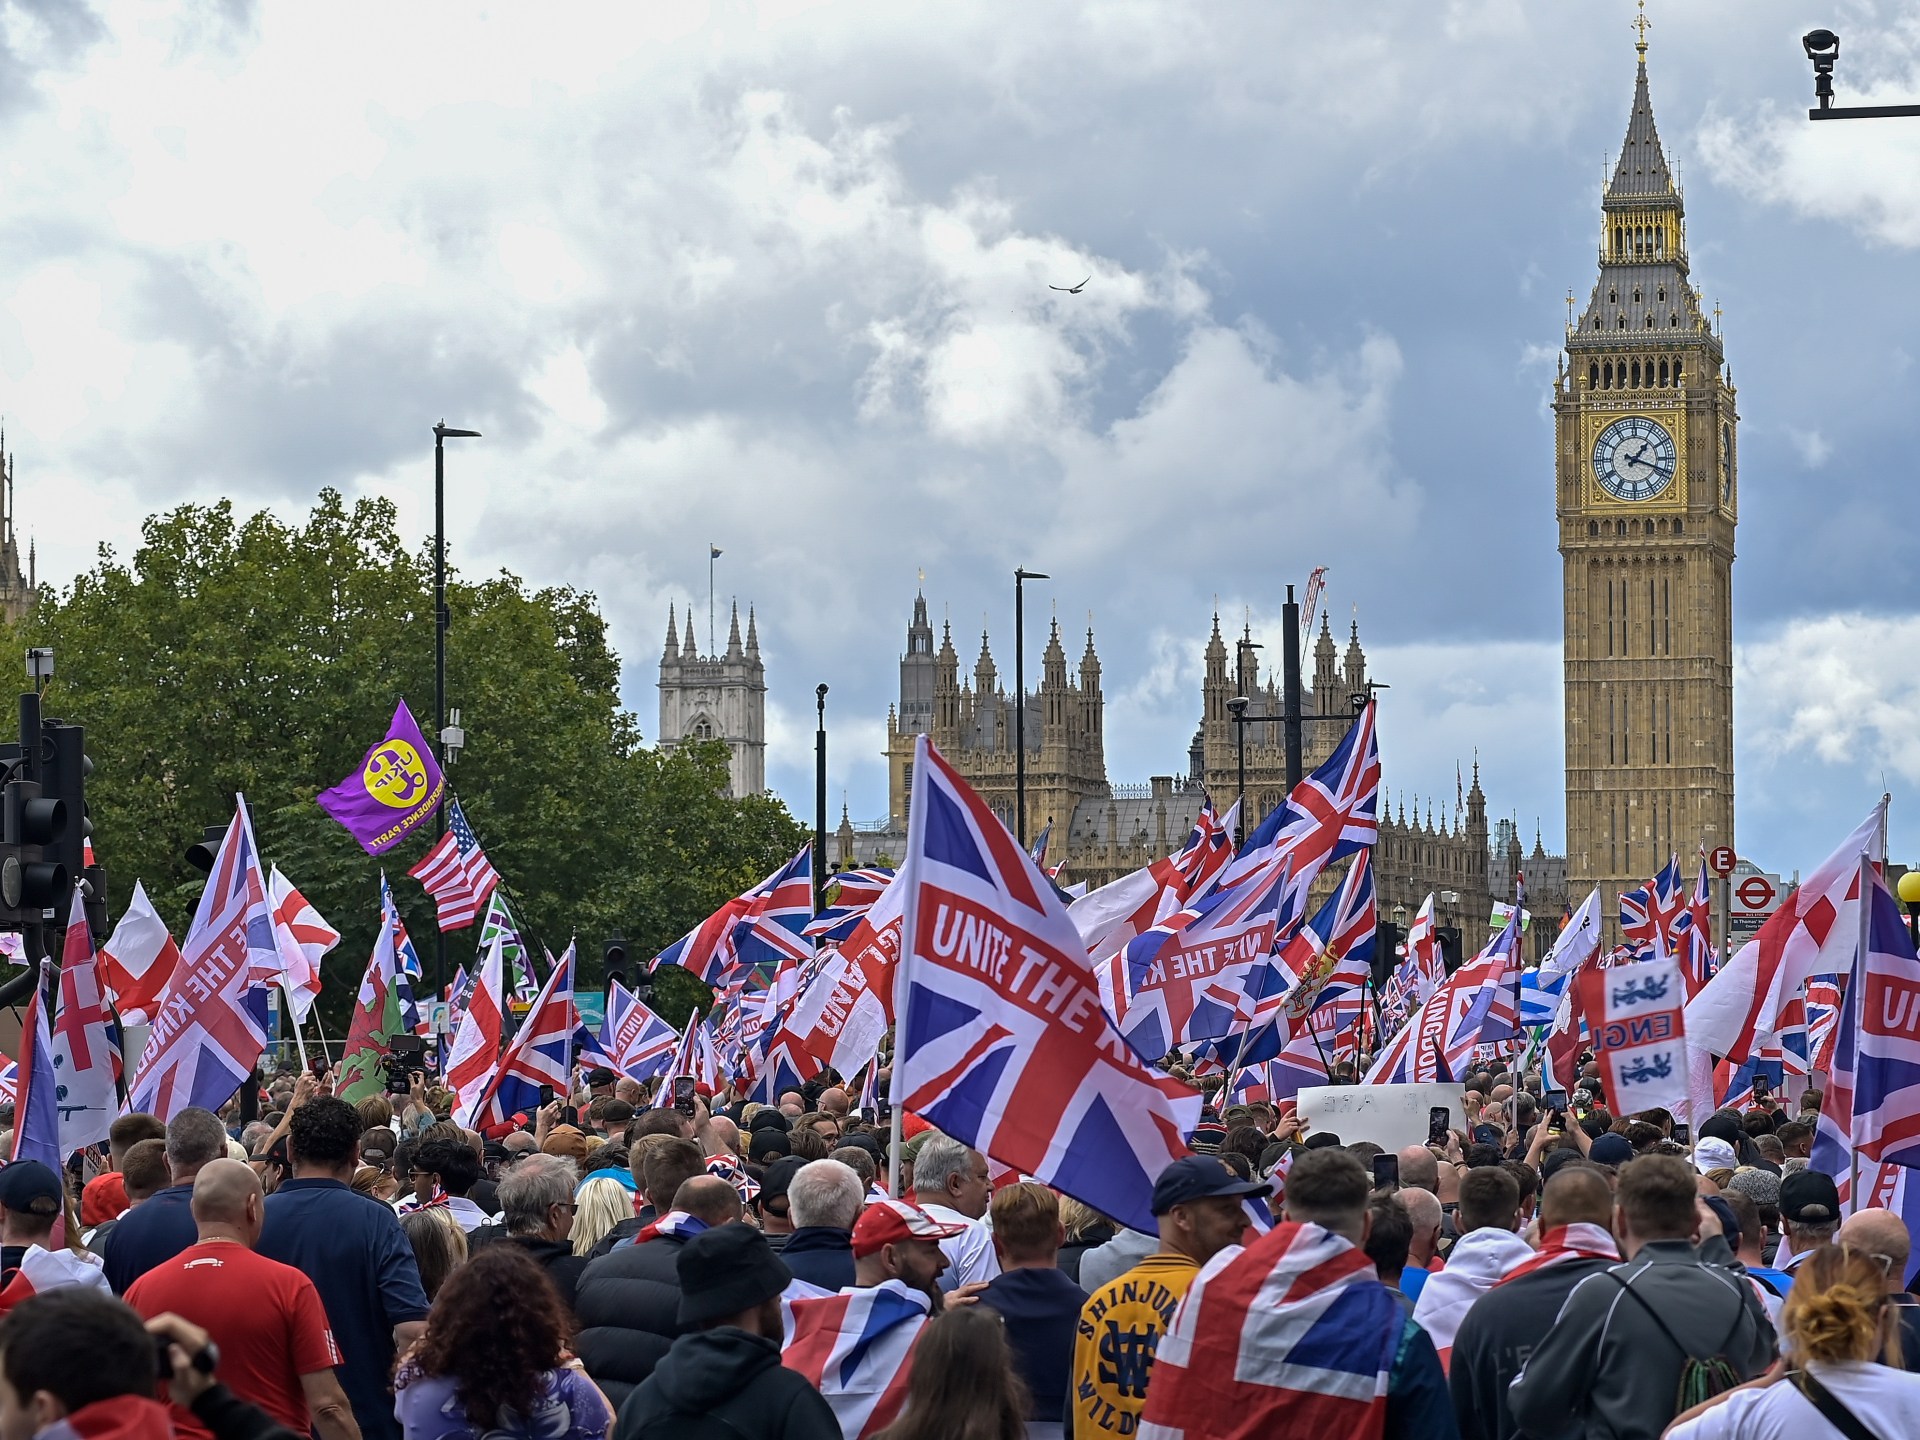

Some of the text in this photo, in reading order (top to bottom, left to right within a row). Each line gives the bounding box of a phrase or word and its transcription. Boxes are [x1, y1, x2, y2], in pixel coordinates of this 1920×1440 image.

[1716, 850, 1730, 870] E
[815, 920, 902, 1038] GLAND
[932, 903, 1013, 985] UNITE
[1009, 944, 1100, 1034] THE
